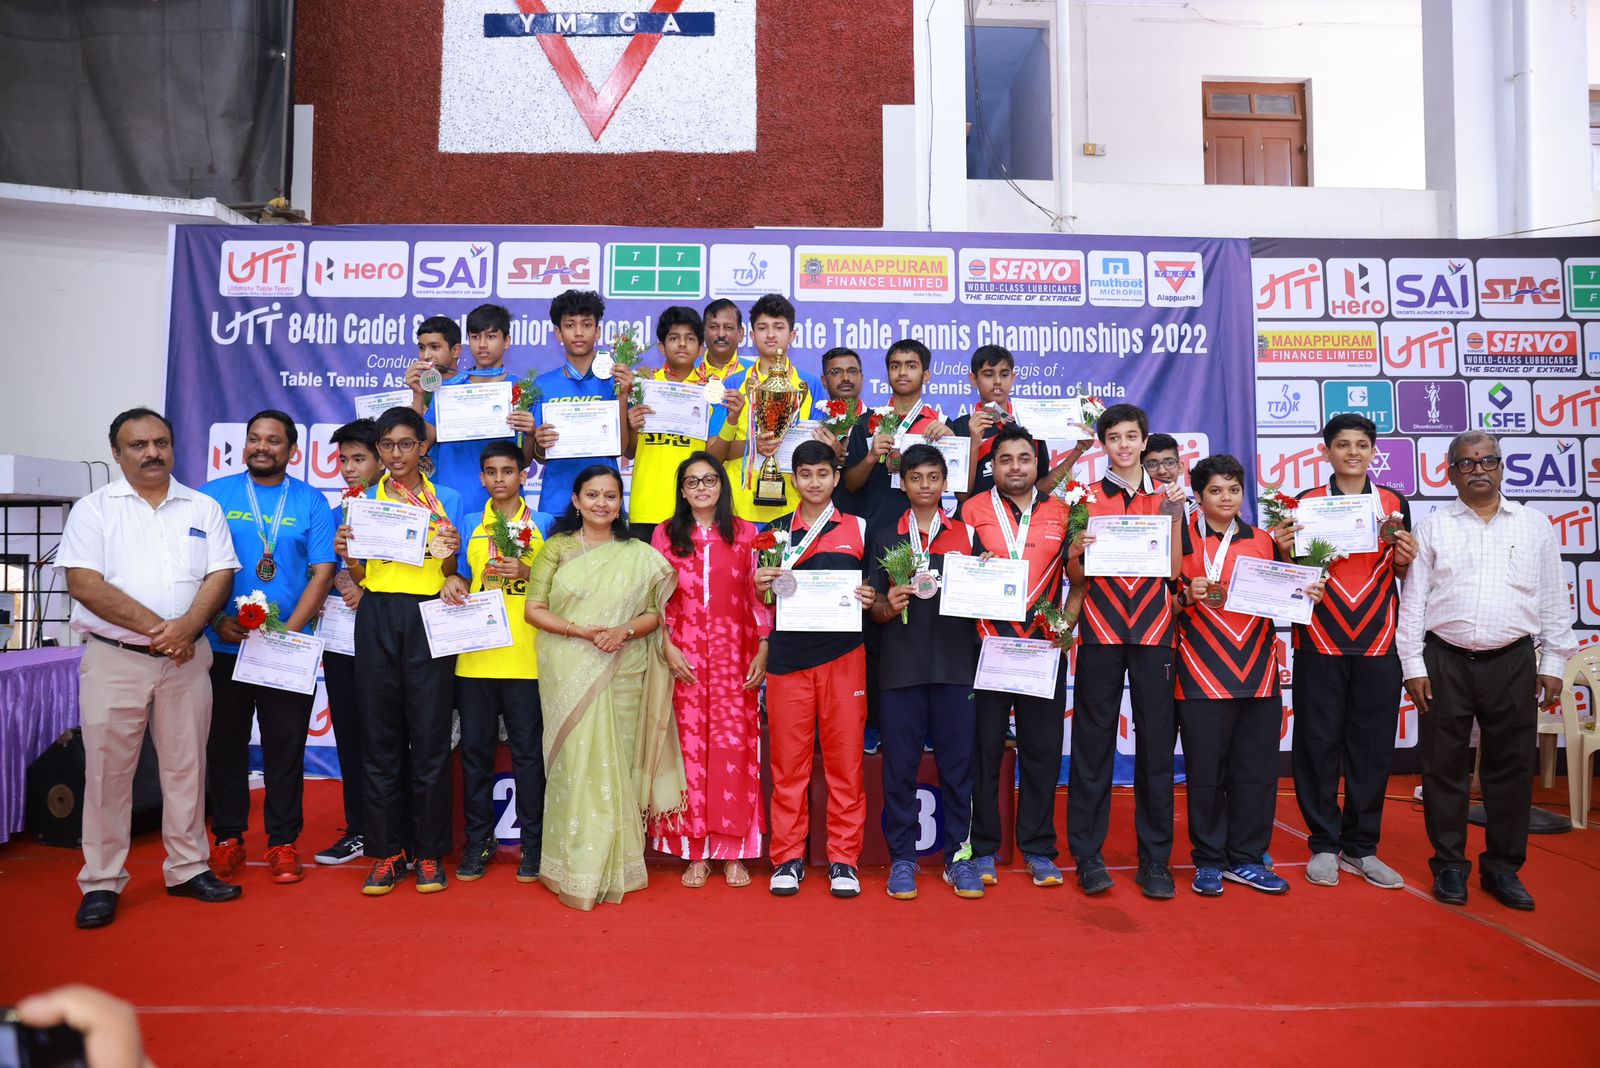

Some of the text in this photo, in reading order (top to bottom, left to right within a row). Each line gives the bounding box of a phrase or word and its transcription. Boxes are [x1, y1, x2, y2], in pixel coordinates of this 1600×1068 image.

[632, 251, 685, 262] T T
[344, 261, 404, 280] Hero
[417, 256, 488, 289] SAI
[507, 255, 590, 285] STAG
[827, 258, 943, 274] MANAPPURAM
[992, 259, 1072, 282] SERVO
[630, 275, 640, 286] F
[826, 276, 943, 289] FINANCE LIMITED
[967, 283, 1077, 294] WORLD-CLASS LUBRICANTS
[1090, 278, 1143, 288] muthoot
[1100, 288, 1143, 296] MICROFIN
[1157, 294, 1196, 302] Alappuzha
[1395, 274, 1470, 308] SAI
[1481, 276, 1560, 304] STAG
[1331, 299, 1385, 315] Hero
[288, 312, 338, 344] 84th
[343, 313, 407, 345] Cadet
[833, 318, 892, 350] Table
[899, 320, 970, 350] Tennis
[977, 320, 1144, 357] Championships
[1151, 323, 1208, 354] 2022
[1271, 335, 1372, 347] MANAPPURAM
[1490, 333, 1568, 353] SERVO
[1272, 350, 1373, 360] FINANCE LIMITED
[1466, 355, 1522, 365] WORLD-CLASS
[1043, 363, 1058, 377] of
[1536, 366, 1578, 374] EXTREME
[280, 371, 323, 387] Table
[326, 372, 378, 388] Tennis
[1088, 382, 1126, 397] India
[1478, 412, 1526, 428] KSFE
[1505, 453, 1576, 487] SAI
[493, 778, 522, 839] 2
